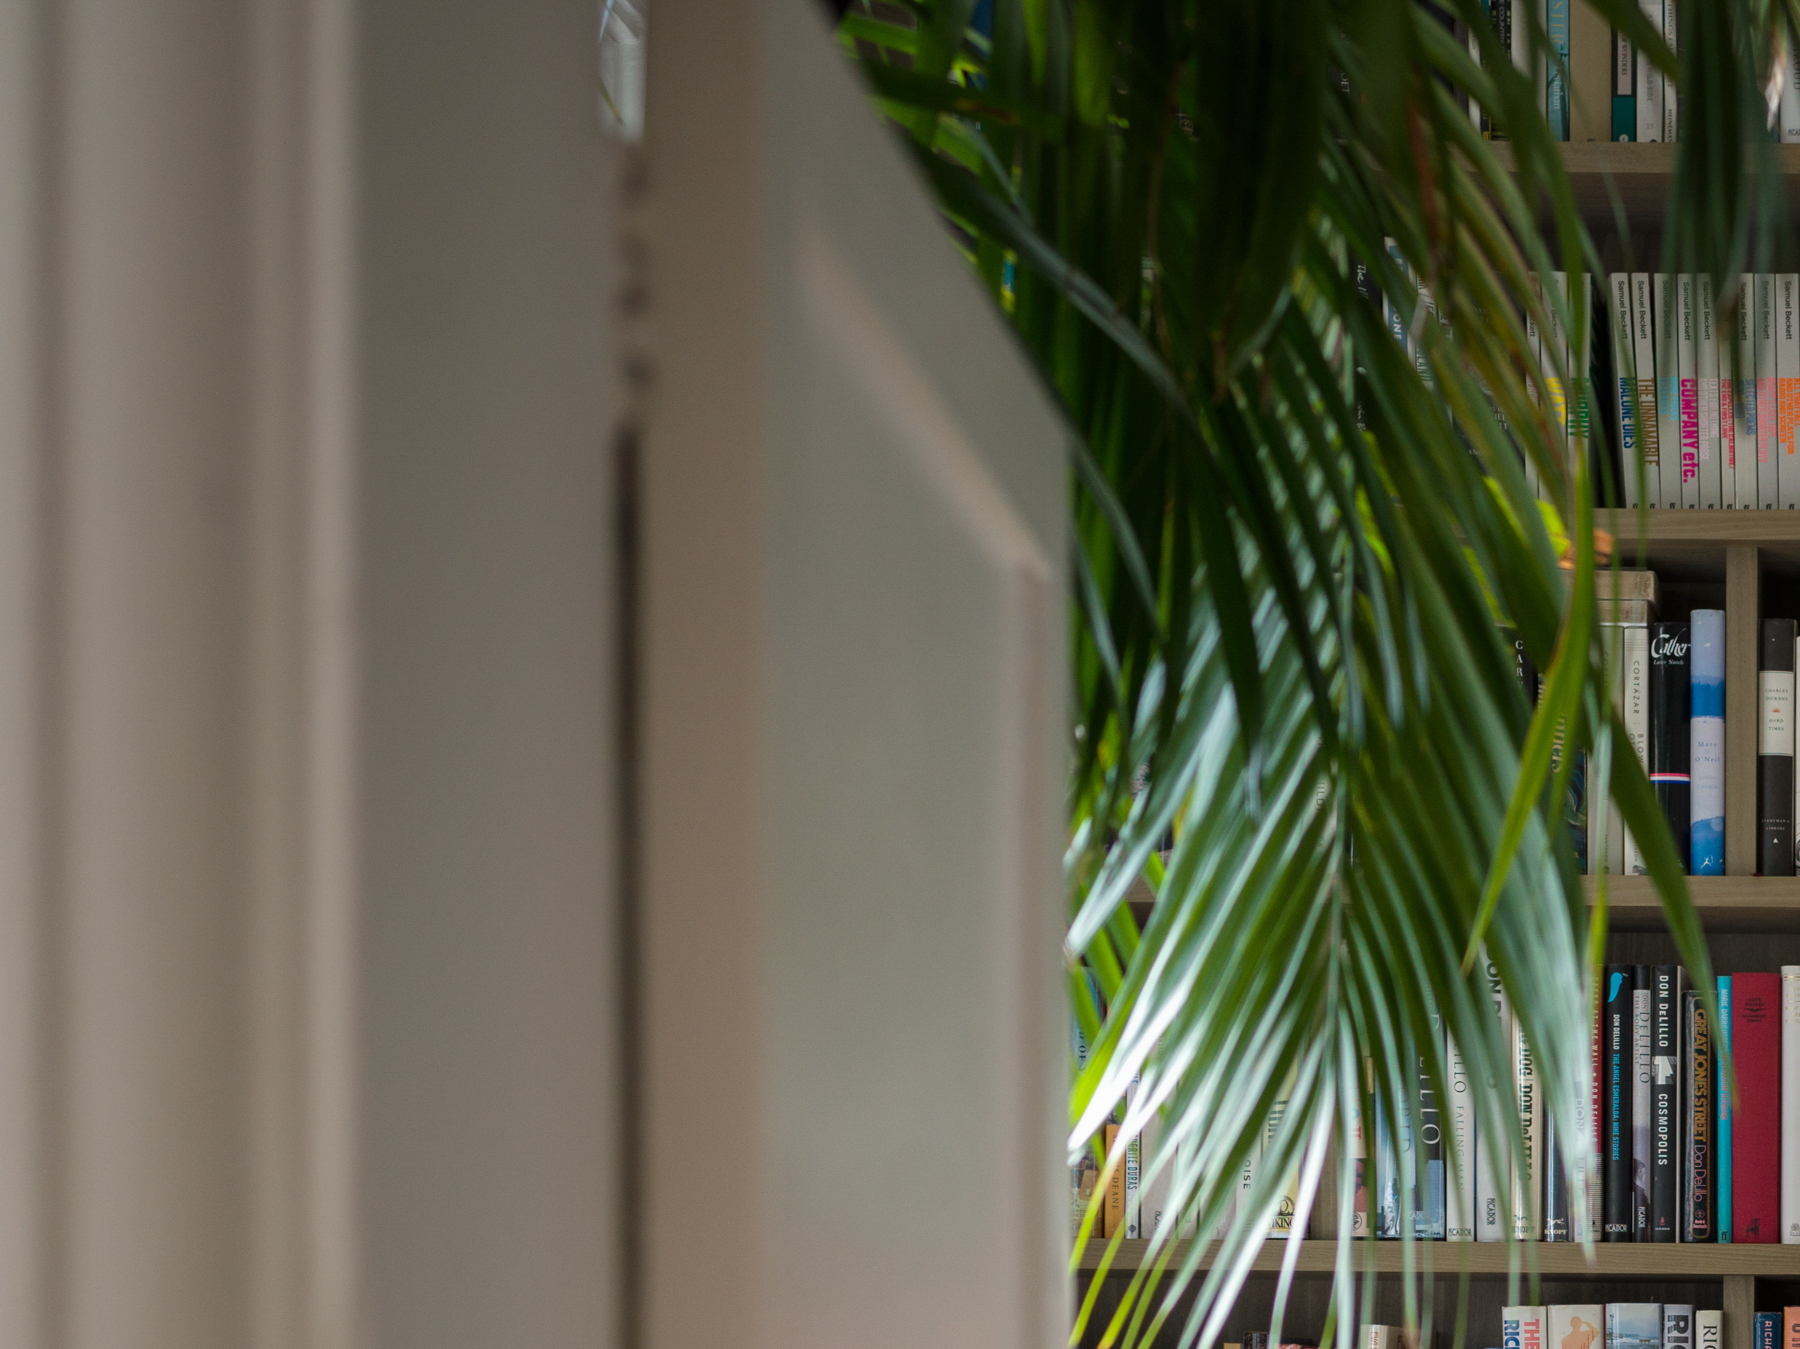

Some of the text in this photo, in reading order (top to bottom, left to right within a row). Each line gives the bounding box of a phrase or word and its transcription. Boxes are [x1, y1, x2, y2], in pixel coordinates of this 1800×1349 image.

[1680, 378, 1698, 483] COMPANY etc.
[1659, 975, 1668, 998] DON
[1658, 1093, 1668, 1165] COSMOPOLIS
